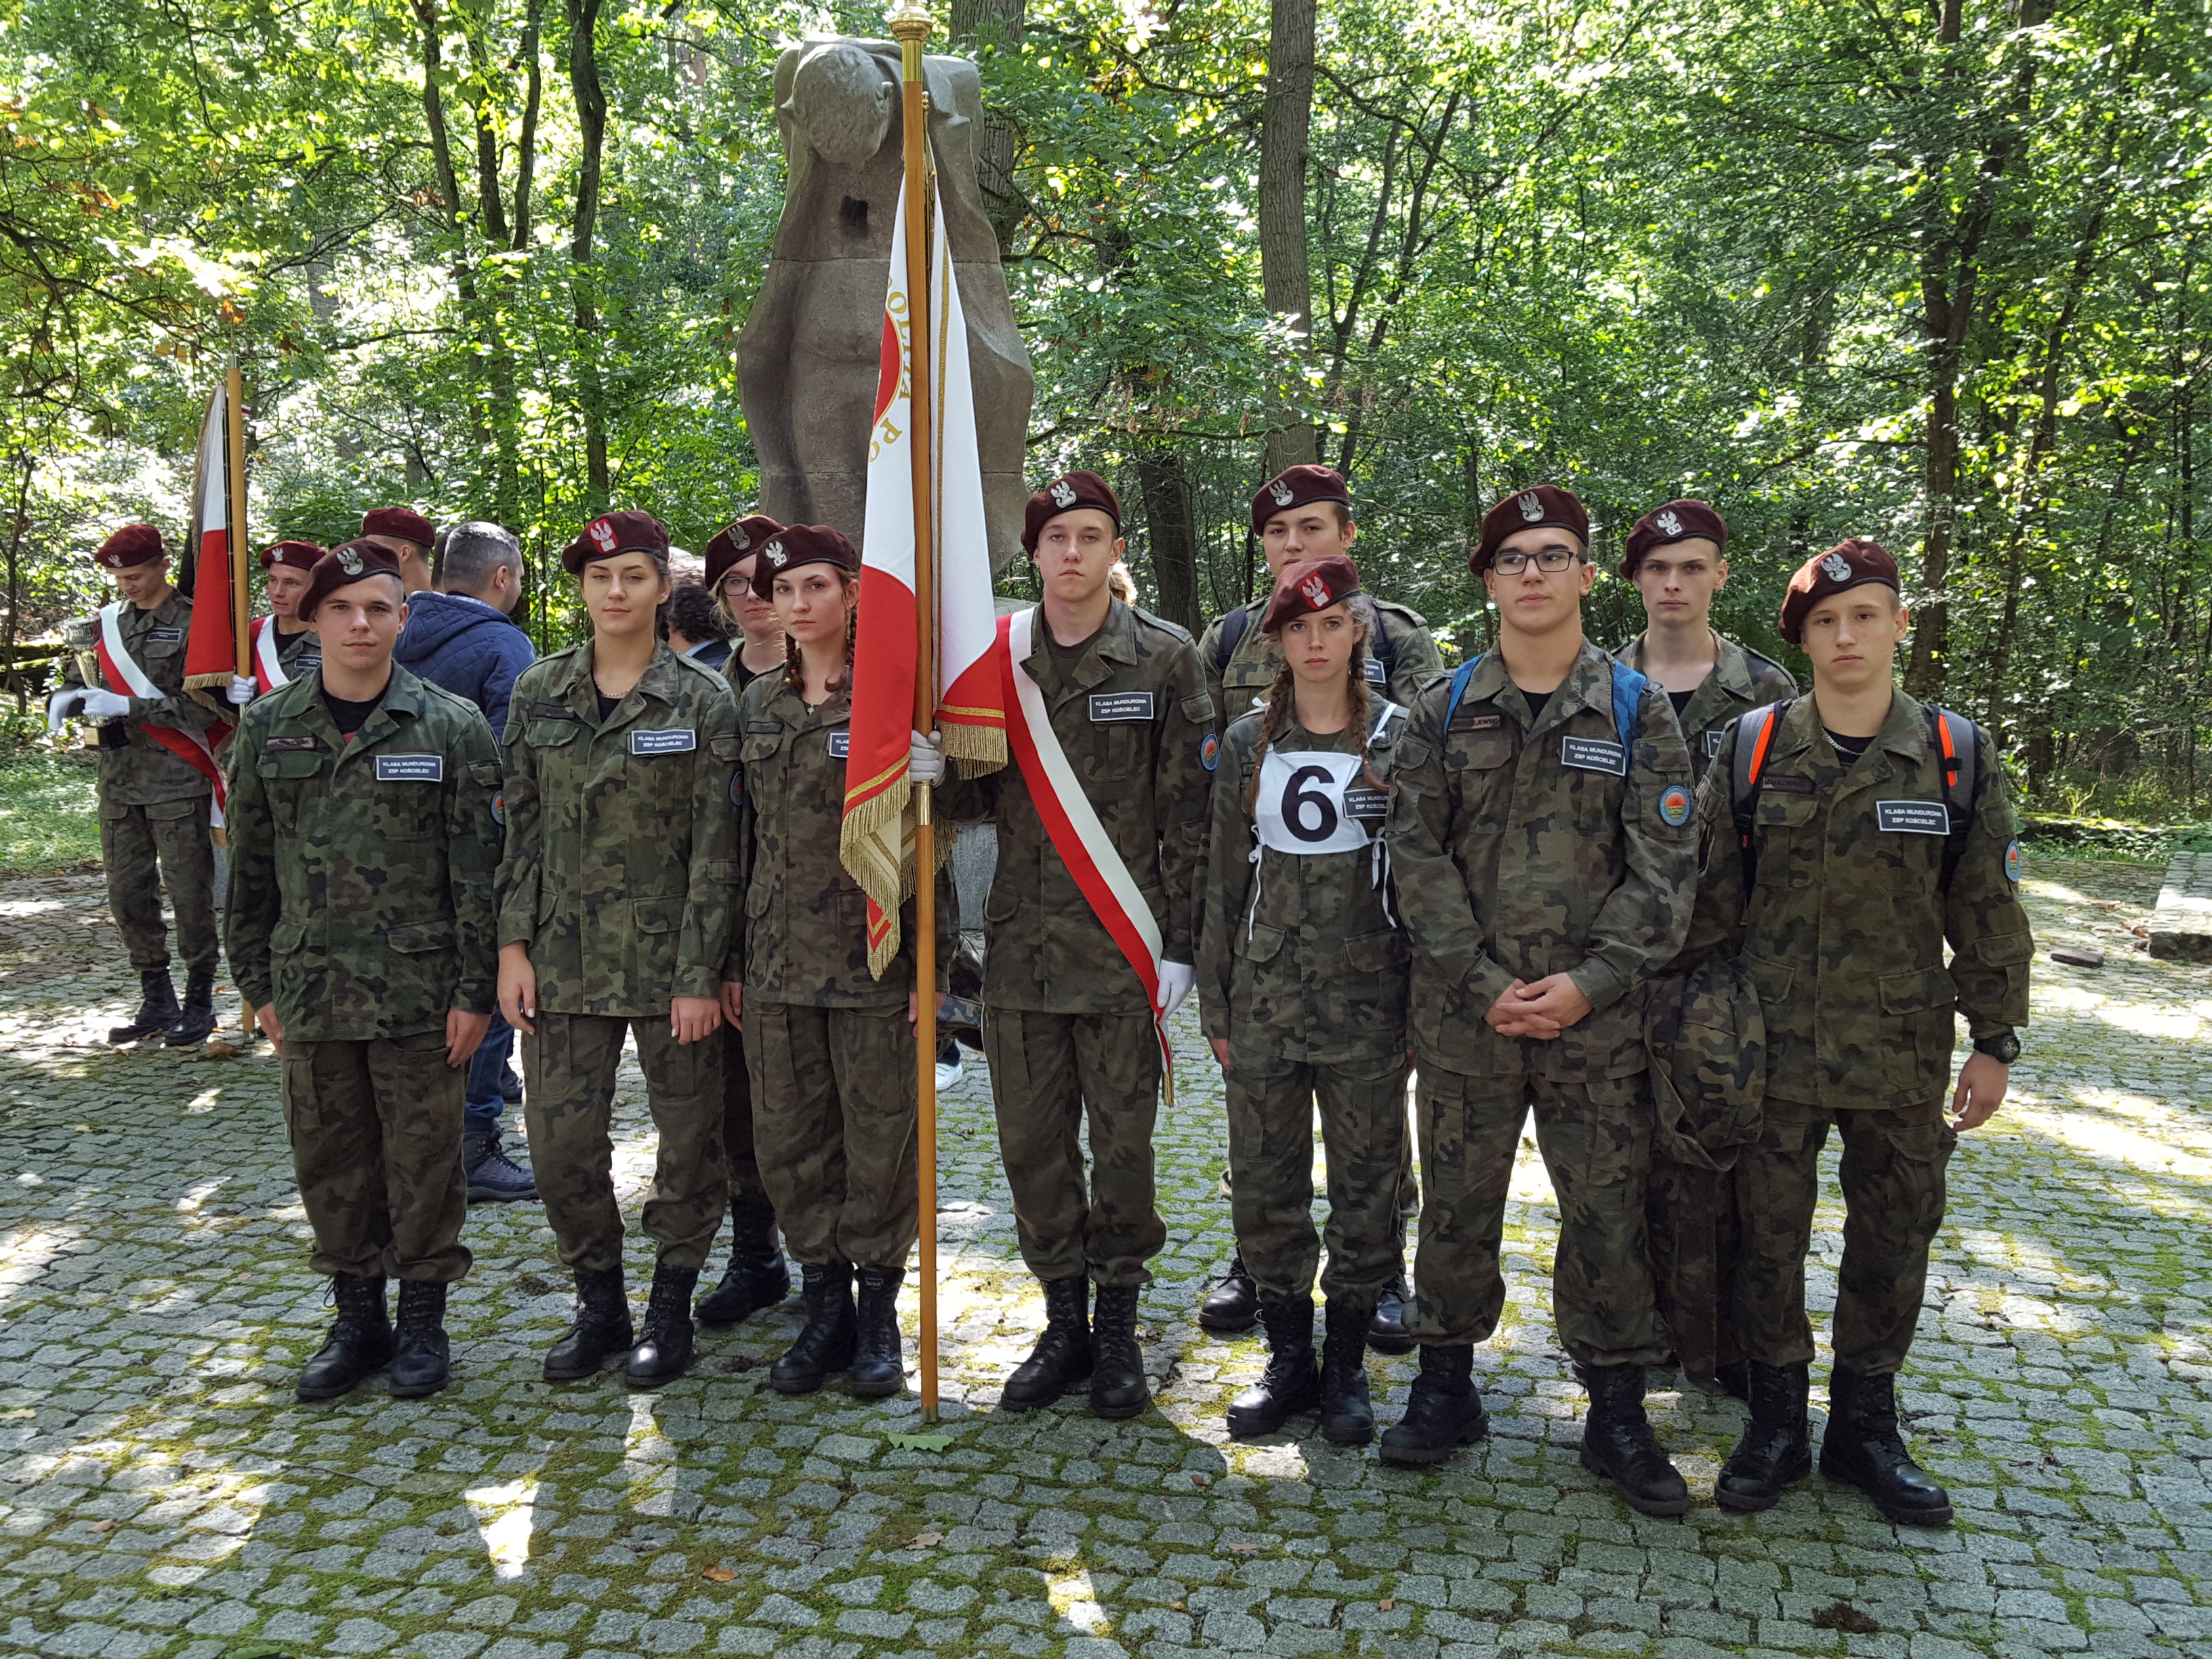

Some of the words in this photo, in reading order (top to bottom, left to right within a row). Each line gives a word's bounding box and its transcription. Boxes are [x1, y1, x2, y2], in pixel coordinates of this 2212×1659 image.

[1589, 747, 1622, 758] MUNDUROWA
[1586, 755, 1616, 765] KOŚCIELEC
[1281, 765, 1338, 842] 6
[1906, 808, 1942, 817] MUNDUROWA
[1905, 817, 1936, 825] KOŚCIELEC
